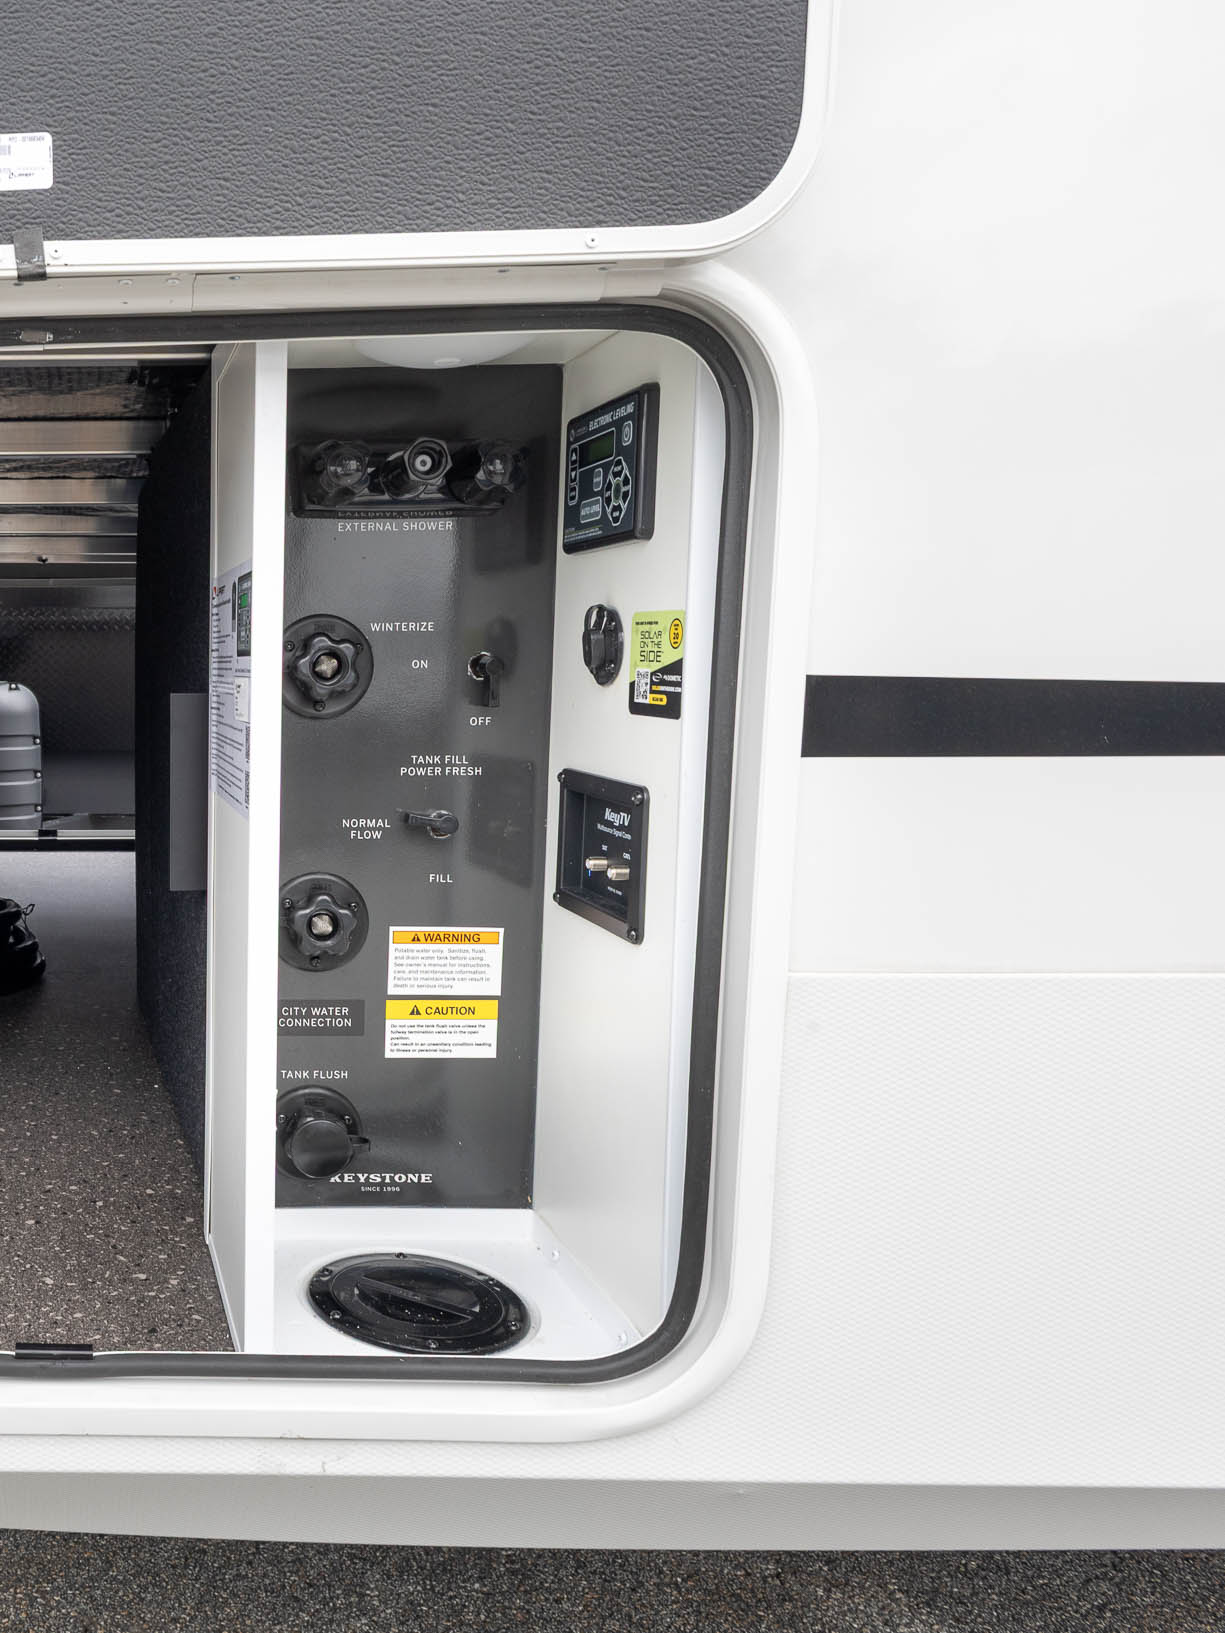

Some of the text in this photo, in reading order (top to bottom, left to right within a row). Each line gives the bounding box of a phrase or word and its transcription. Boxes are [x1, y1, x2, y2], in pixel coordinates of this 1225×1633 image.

[338, 521, 453, 532] EXTERNAL SHOWER
[370, 622, 434, 632] WINTERIZE
[640, 631, 663, 640] SOLAR
[640, 641, 662, 649] ON THE
[639, 651, 662, 662] SIDE
[411, 660, 428, 669] ON
[469, 717, 492, 726] OFF
[411, 755, 469, 764] TANK FILL
[400, 767, 482, 776] POWER FRESH
[604, 807, 631, 827] KeyTV
[342, 819, 391, 828] NORMAL
[350, 831, 382, 840] FLOW
[429, 874, 453, 883] FILL
[423, 933, 481, 943] WARNING
[282, 1007, 349, 1016] CITY WATER
[425, 1006, 476, 1015] CAUTION
[278, 1018, 352, 1027] CONNECTION
[281, 1070, 348, 1079] TANK FLUSH
[329, 1173, 433, 1183] KEYSTONE
